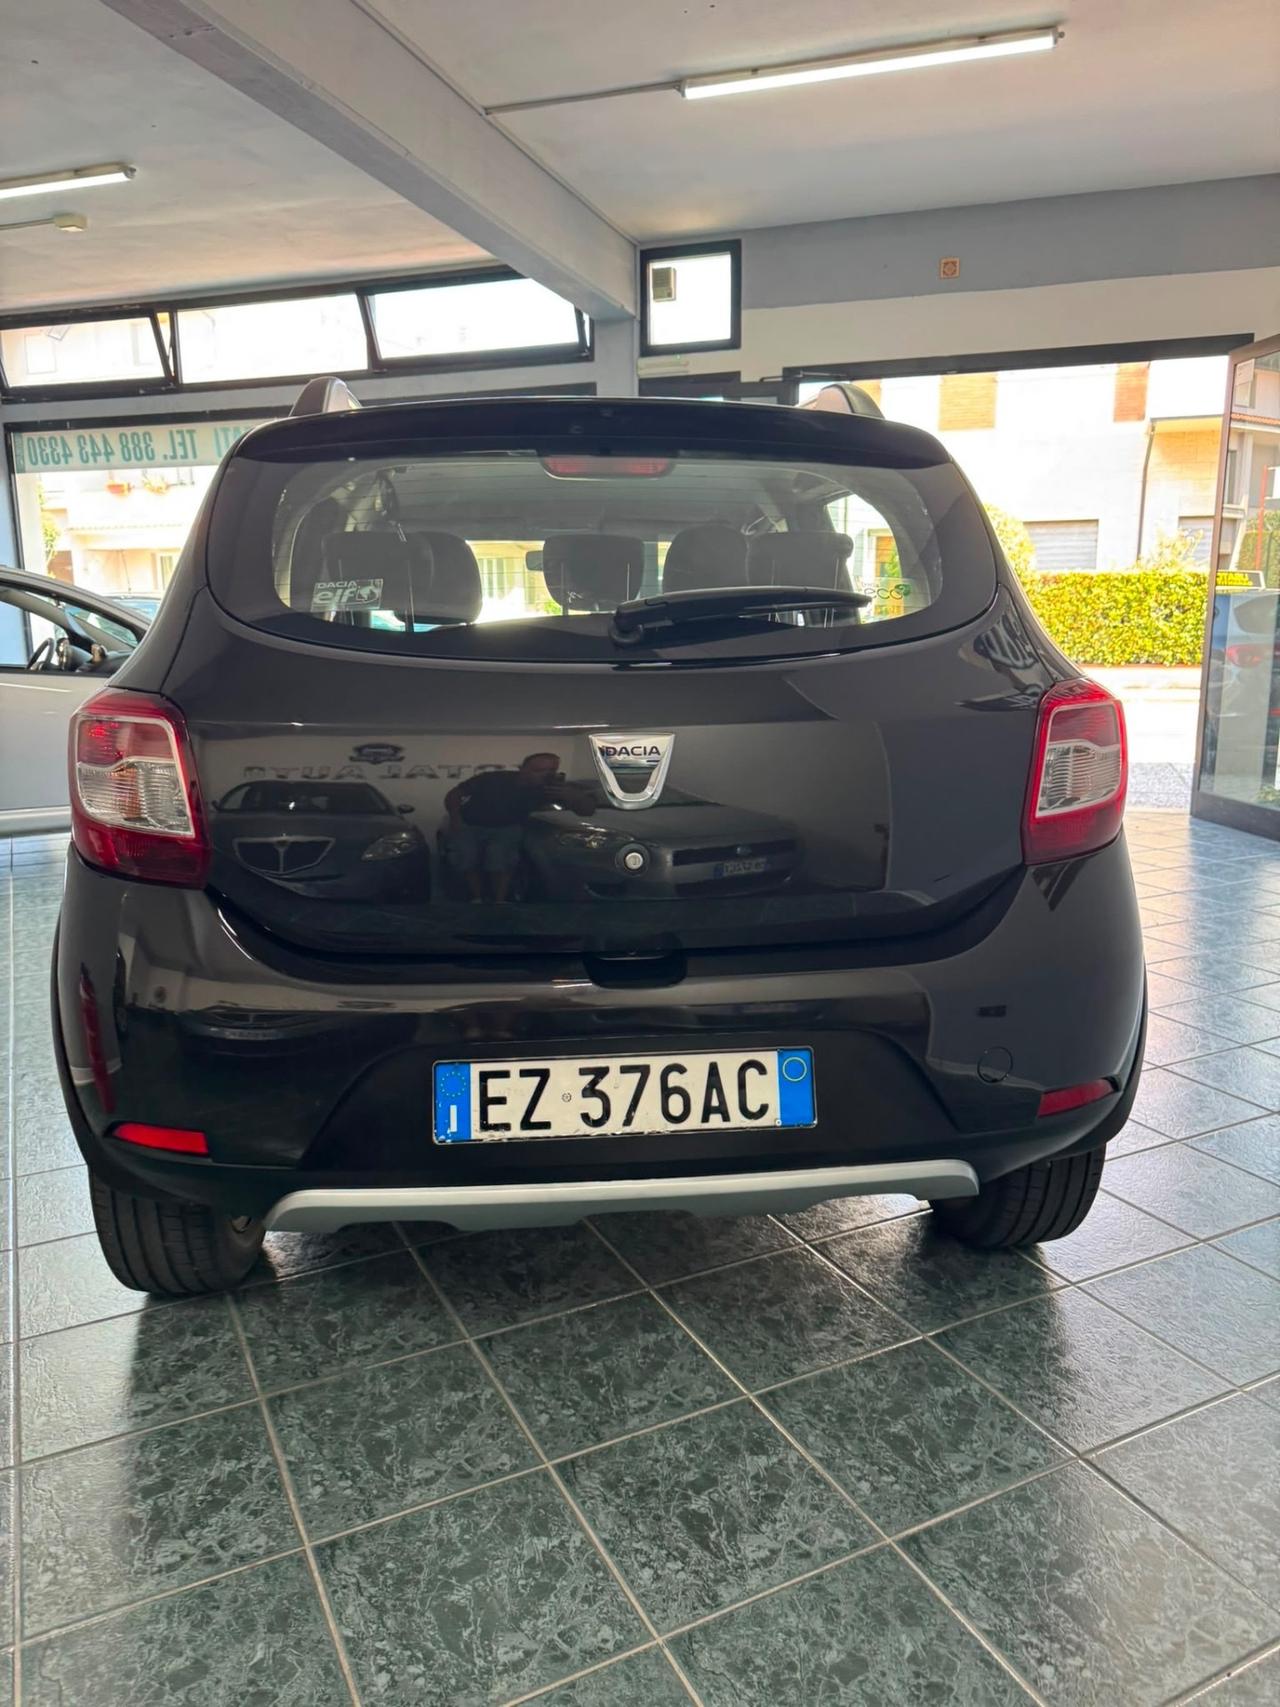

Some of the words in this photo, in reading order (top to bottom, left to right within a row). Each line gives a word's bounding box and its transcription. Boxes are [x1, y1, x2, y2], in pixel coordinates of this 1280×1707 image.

[313, 588, 356, 603] elf
[604, 746, 661, 756] DACIA
[479, 1068, 552, 1131] EZ
[579, 1059, 769, 1128] 376AC
